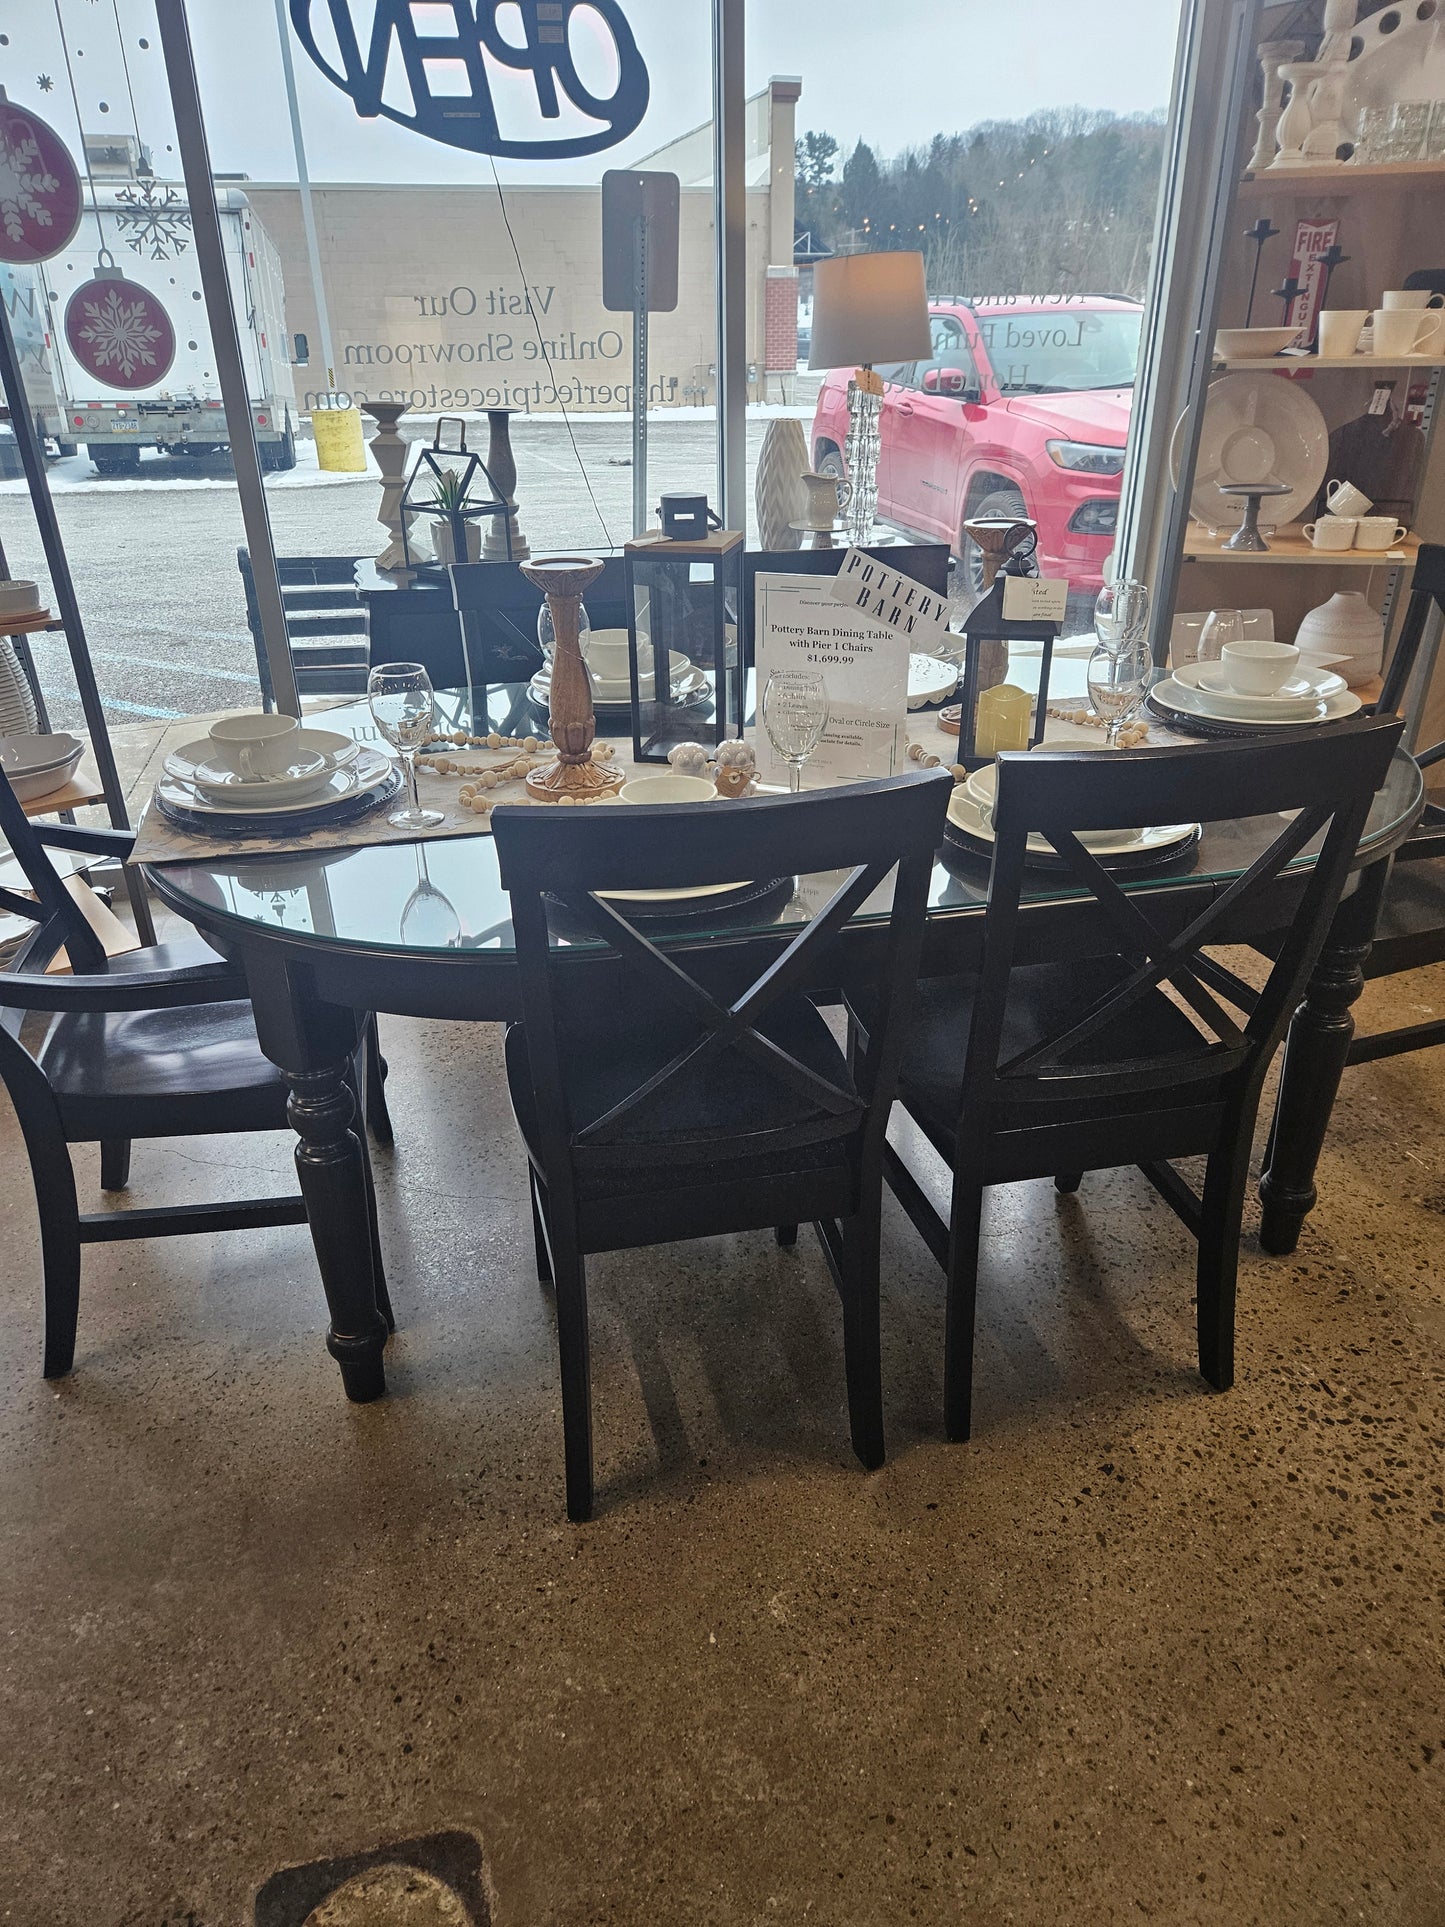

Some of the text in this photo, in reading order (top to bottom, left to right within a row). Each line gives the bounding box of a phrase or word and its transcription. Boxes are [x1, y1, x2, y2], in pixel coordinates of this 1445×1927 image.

[1297, 231, 1334, 252] FIRE
[847, 554, 947, 622] POTTERY
[856, 586, 918, 634] BARN
[771, 624, 894, 640] Pottery Barn Dining Table
[789, 639, 874, 652] with Pier 1 Chairs
[806, 653, 855, 664] $1,699.99
[829, 717, 845, 726] Oval
[854, 718, 875, 728] Circle
[875, 719, 890, 729] Size
